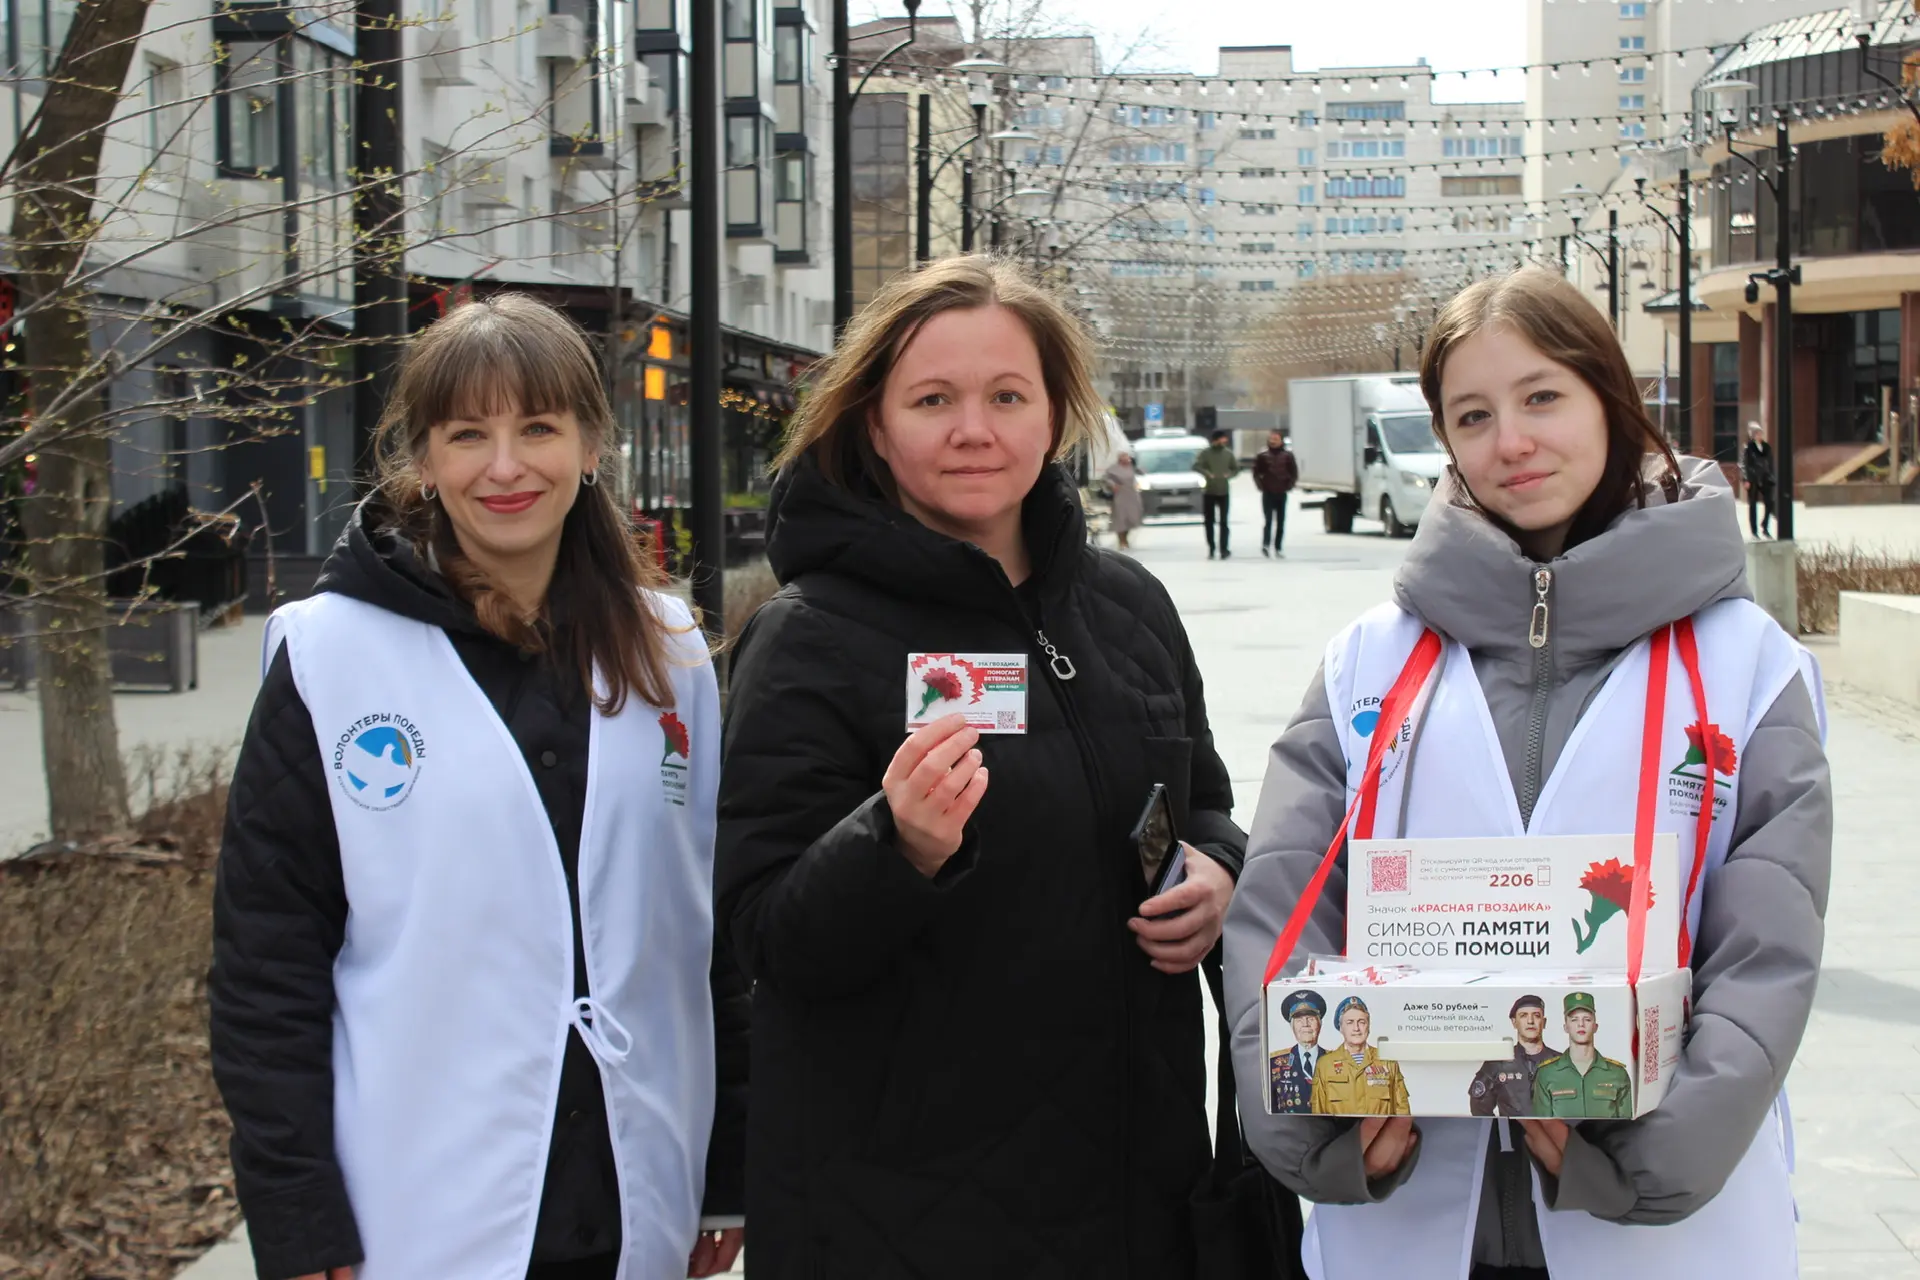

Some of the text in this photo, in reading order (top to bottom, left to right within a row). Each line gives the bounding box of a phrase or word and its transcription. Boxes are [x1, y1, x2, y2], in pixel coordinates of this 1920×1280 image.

[334, 713, 426, 770] ВОЛОНТЕРЫ ПОБЕДЫ
[1669, 778, 1706, 792] ПАМЯТ
[1489, 873, 1534, 887] 2206
[1367, 902, 1551, 914] Значок «КРАСНАЯ ГВОЗДИКА»
[1367, 920, 1550, 937] СИМВОЛ ПАМЯТИ
[1367, 940, 1550, 957] СПОСОБ ПОМОЩИ
[1403, 1003, 1429, 1011] Даже
[1445, 1002, 1479, 1011] рублей
[1408, 1013, 1456, 1021] ощутимый
[1443, 1024, 1494, 1032] ветеранам!
